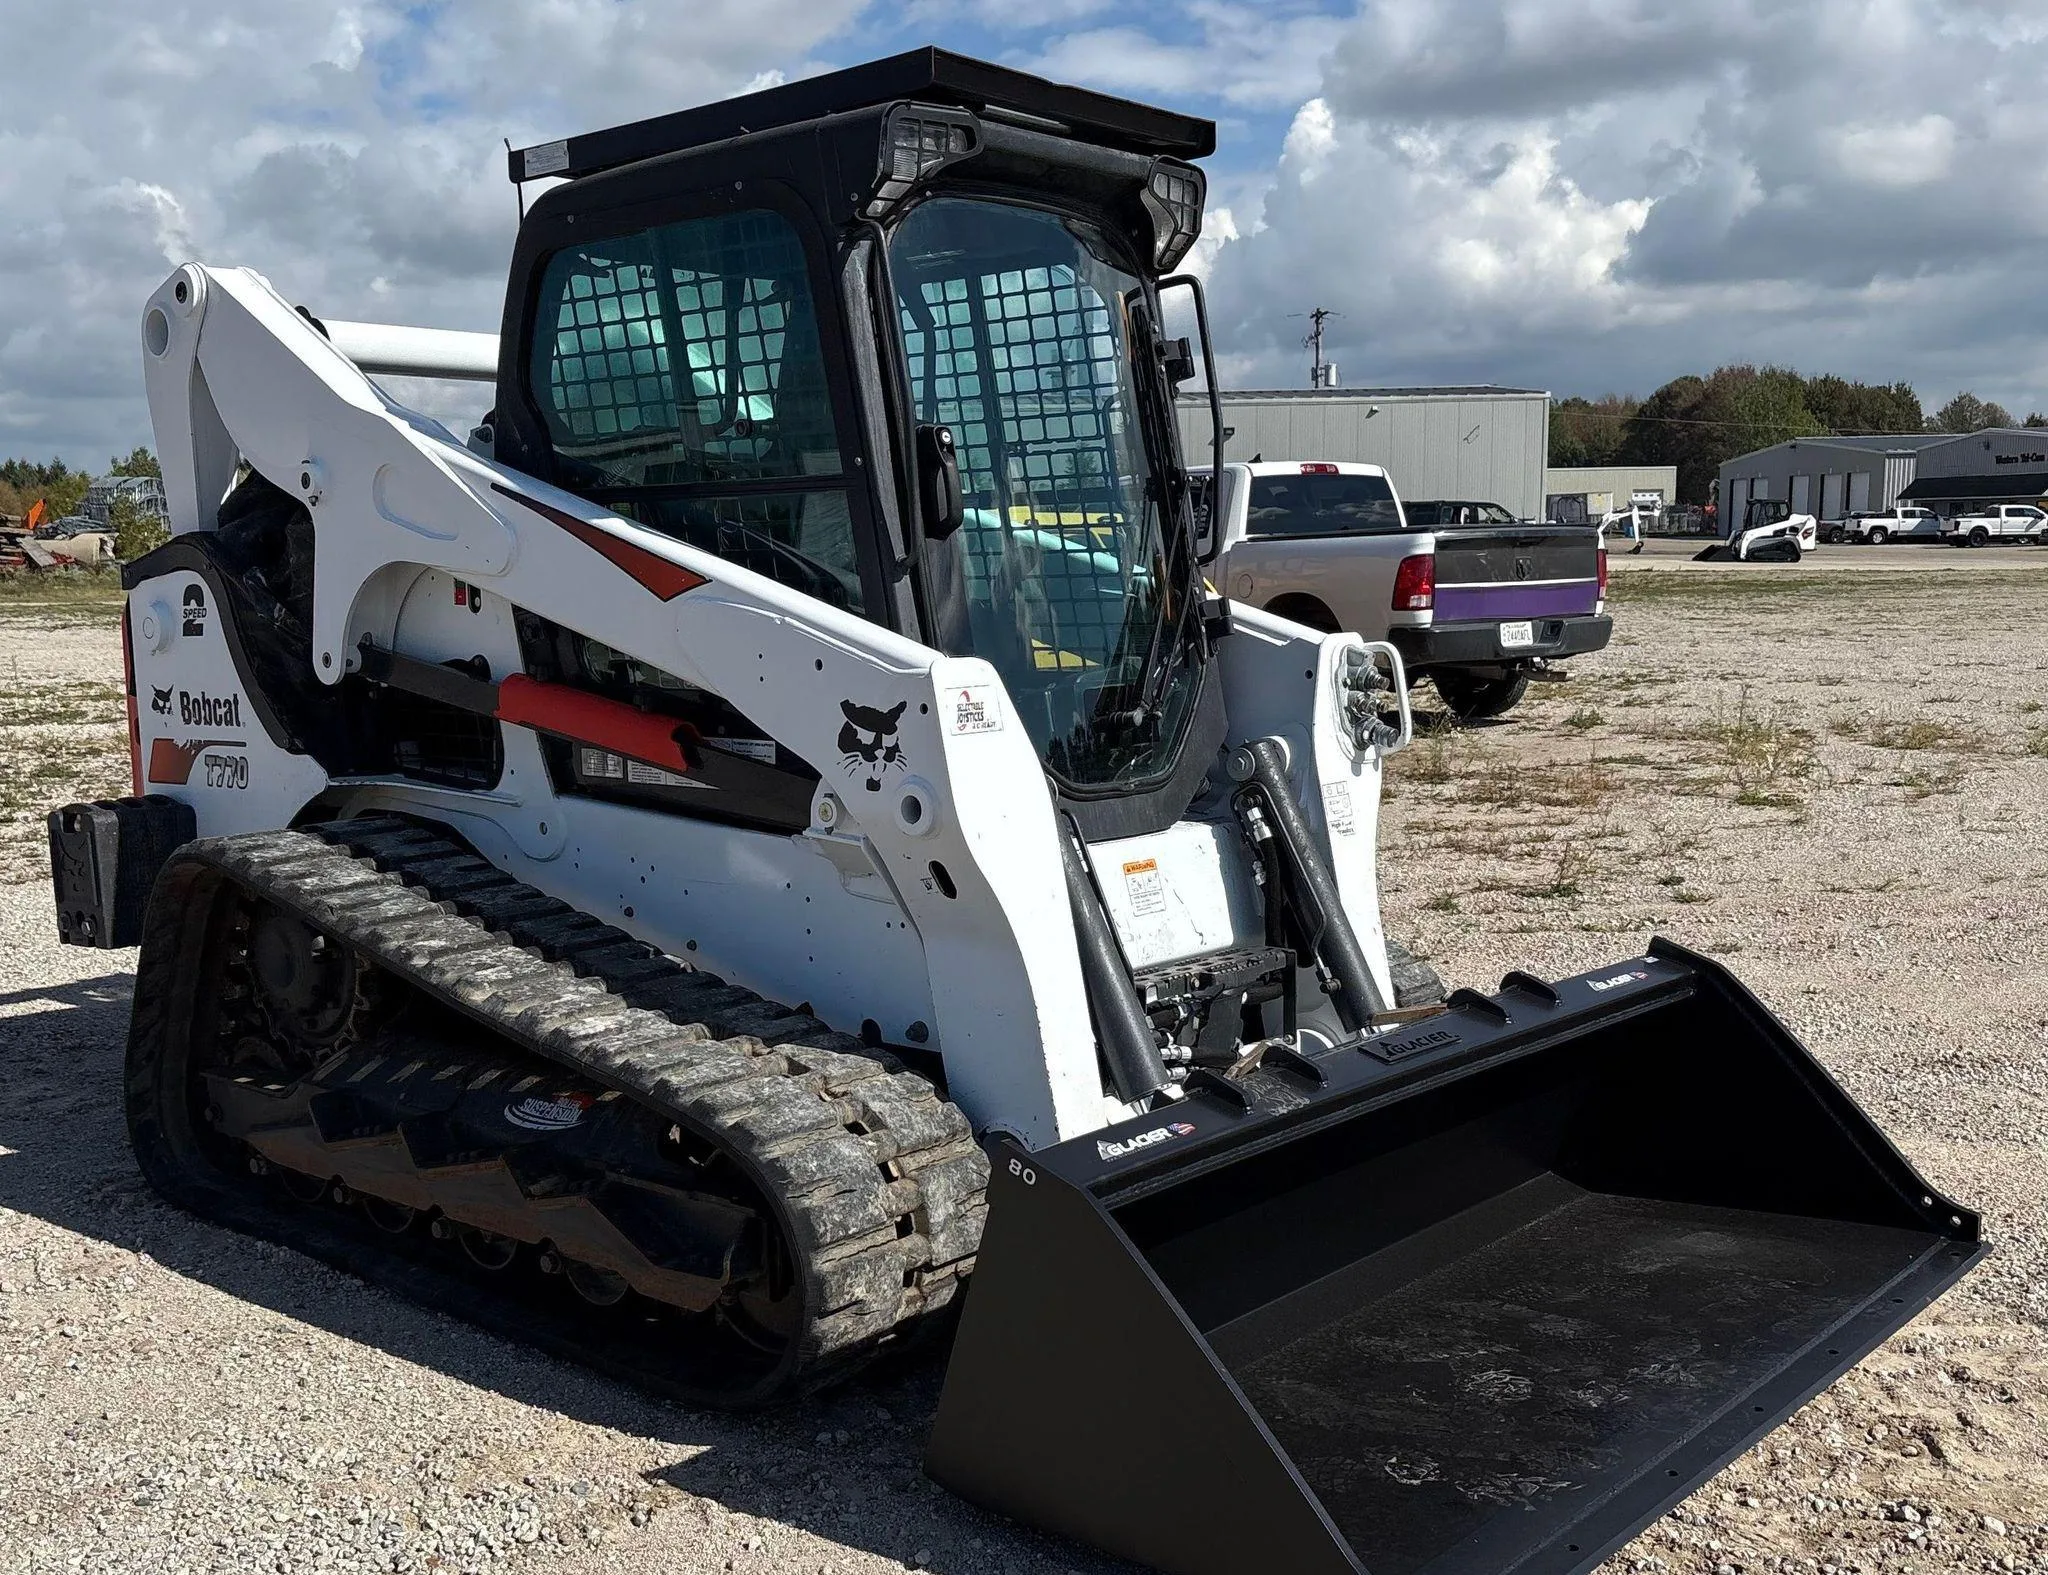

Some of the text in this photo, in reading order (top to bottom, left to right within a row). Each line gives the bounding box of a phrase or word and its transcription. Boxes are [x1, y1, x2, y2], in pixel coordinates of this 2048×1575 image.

[183, 607, 207, 619] SPEED
[179, 691, 241, 727] Bobcat
[957, 711, 984, 724] JOYSTICKS
[204, 754, 249, 789] T770
[1131, 861, 1155, 871] WARNING
[1595, 973, 1635, 990] GLACIER
[1391, 1030, 1453, 1054] GLACIER
[518, 1097, 584, 1122] SUSPENSION
[1106, 1127, 1173, 1156] GLACIER
[1008, 1158, 1037, 1186] 80
